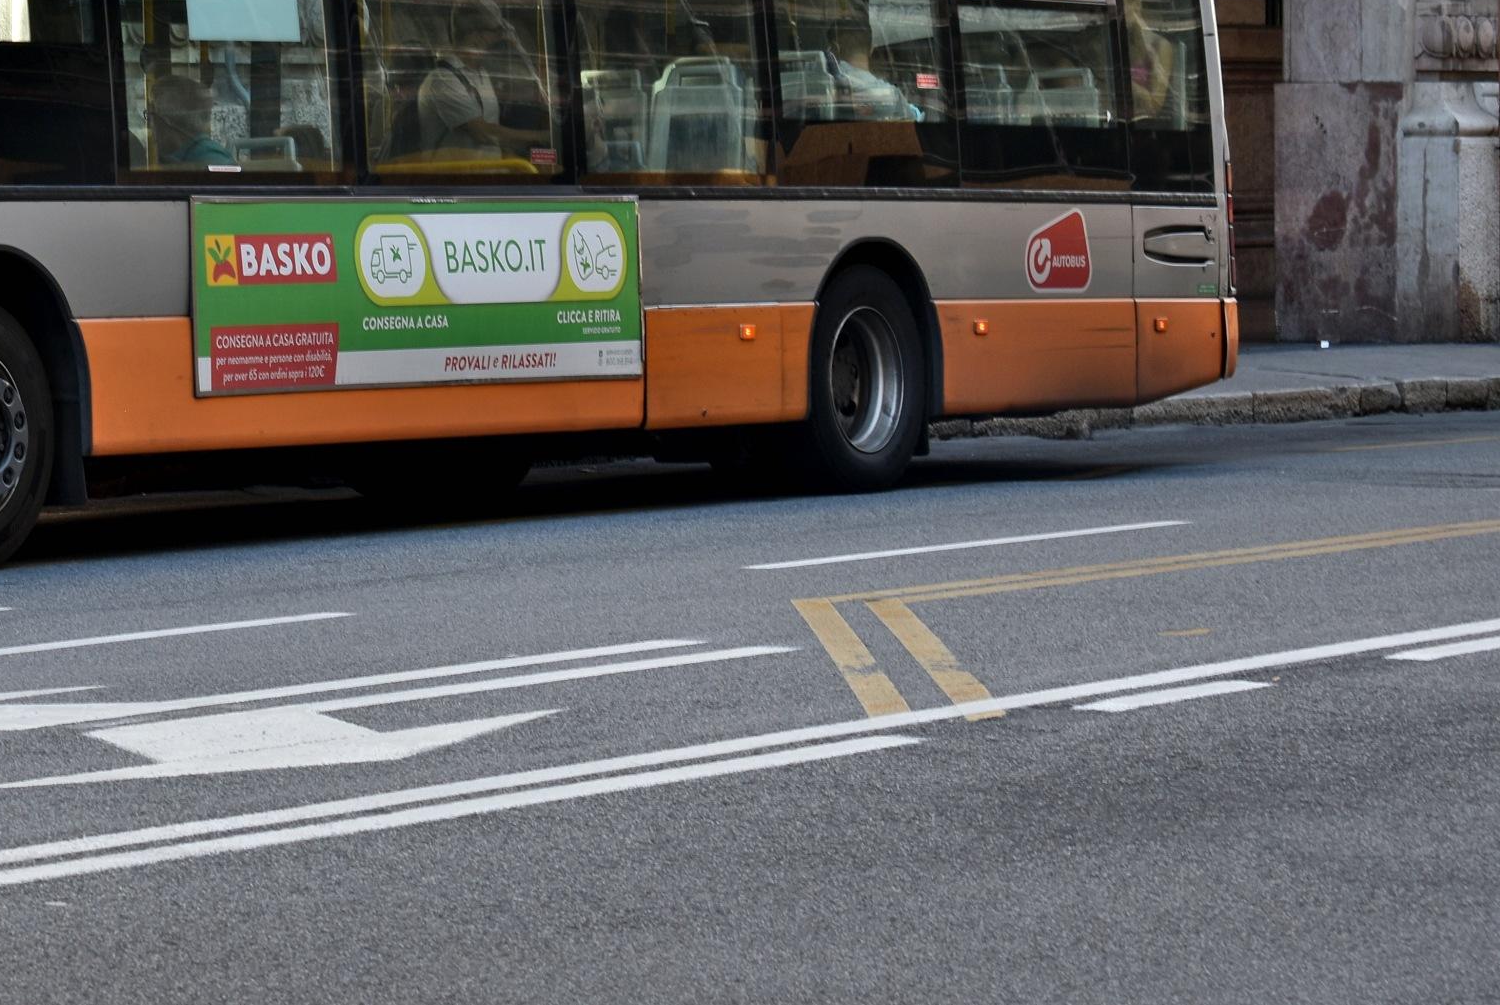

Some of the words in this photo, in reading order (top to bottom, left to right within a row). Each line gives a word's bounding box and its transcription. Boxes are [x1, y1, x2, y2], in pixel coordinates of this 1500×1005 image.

[240, 242, 332, 277] BASKO
[444, 239, 546, 274] BASKO.IT
[1052, 254, 1086, 268] AUTOBUS
[362, 315, 415, 330] CONSEGNA
[416, 315, 423, 329] A
[424, 314, 449, 328] CASA
[557, 309, 587, 324] CLICCA
[588, 310, 594, 323] E
[595, 308, 621, 323] RITIRA
[216, 335, 264, 349] CONSEGNA
[265, 334, 271, 347] A
[272, 333, 294, 347] CASA
[295, 331, 334, 346] GRATUITA
[216, 357, 226, 370] per
[269, 354, 292, 368] persone
[293, 354, 304, 363] con
[444, 355, 491, 372] PROVALI
[493, 357, 499, 369] e
[501, 352, 557, 370] RILASSATI!
[223, 373, 233, 386] per
[258, 371, 269, 380] con
